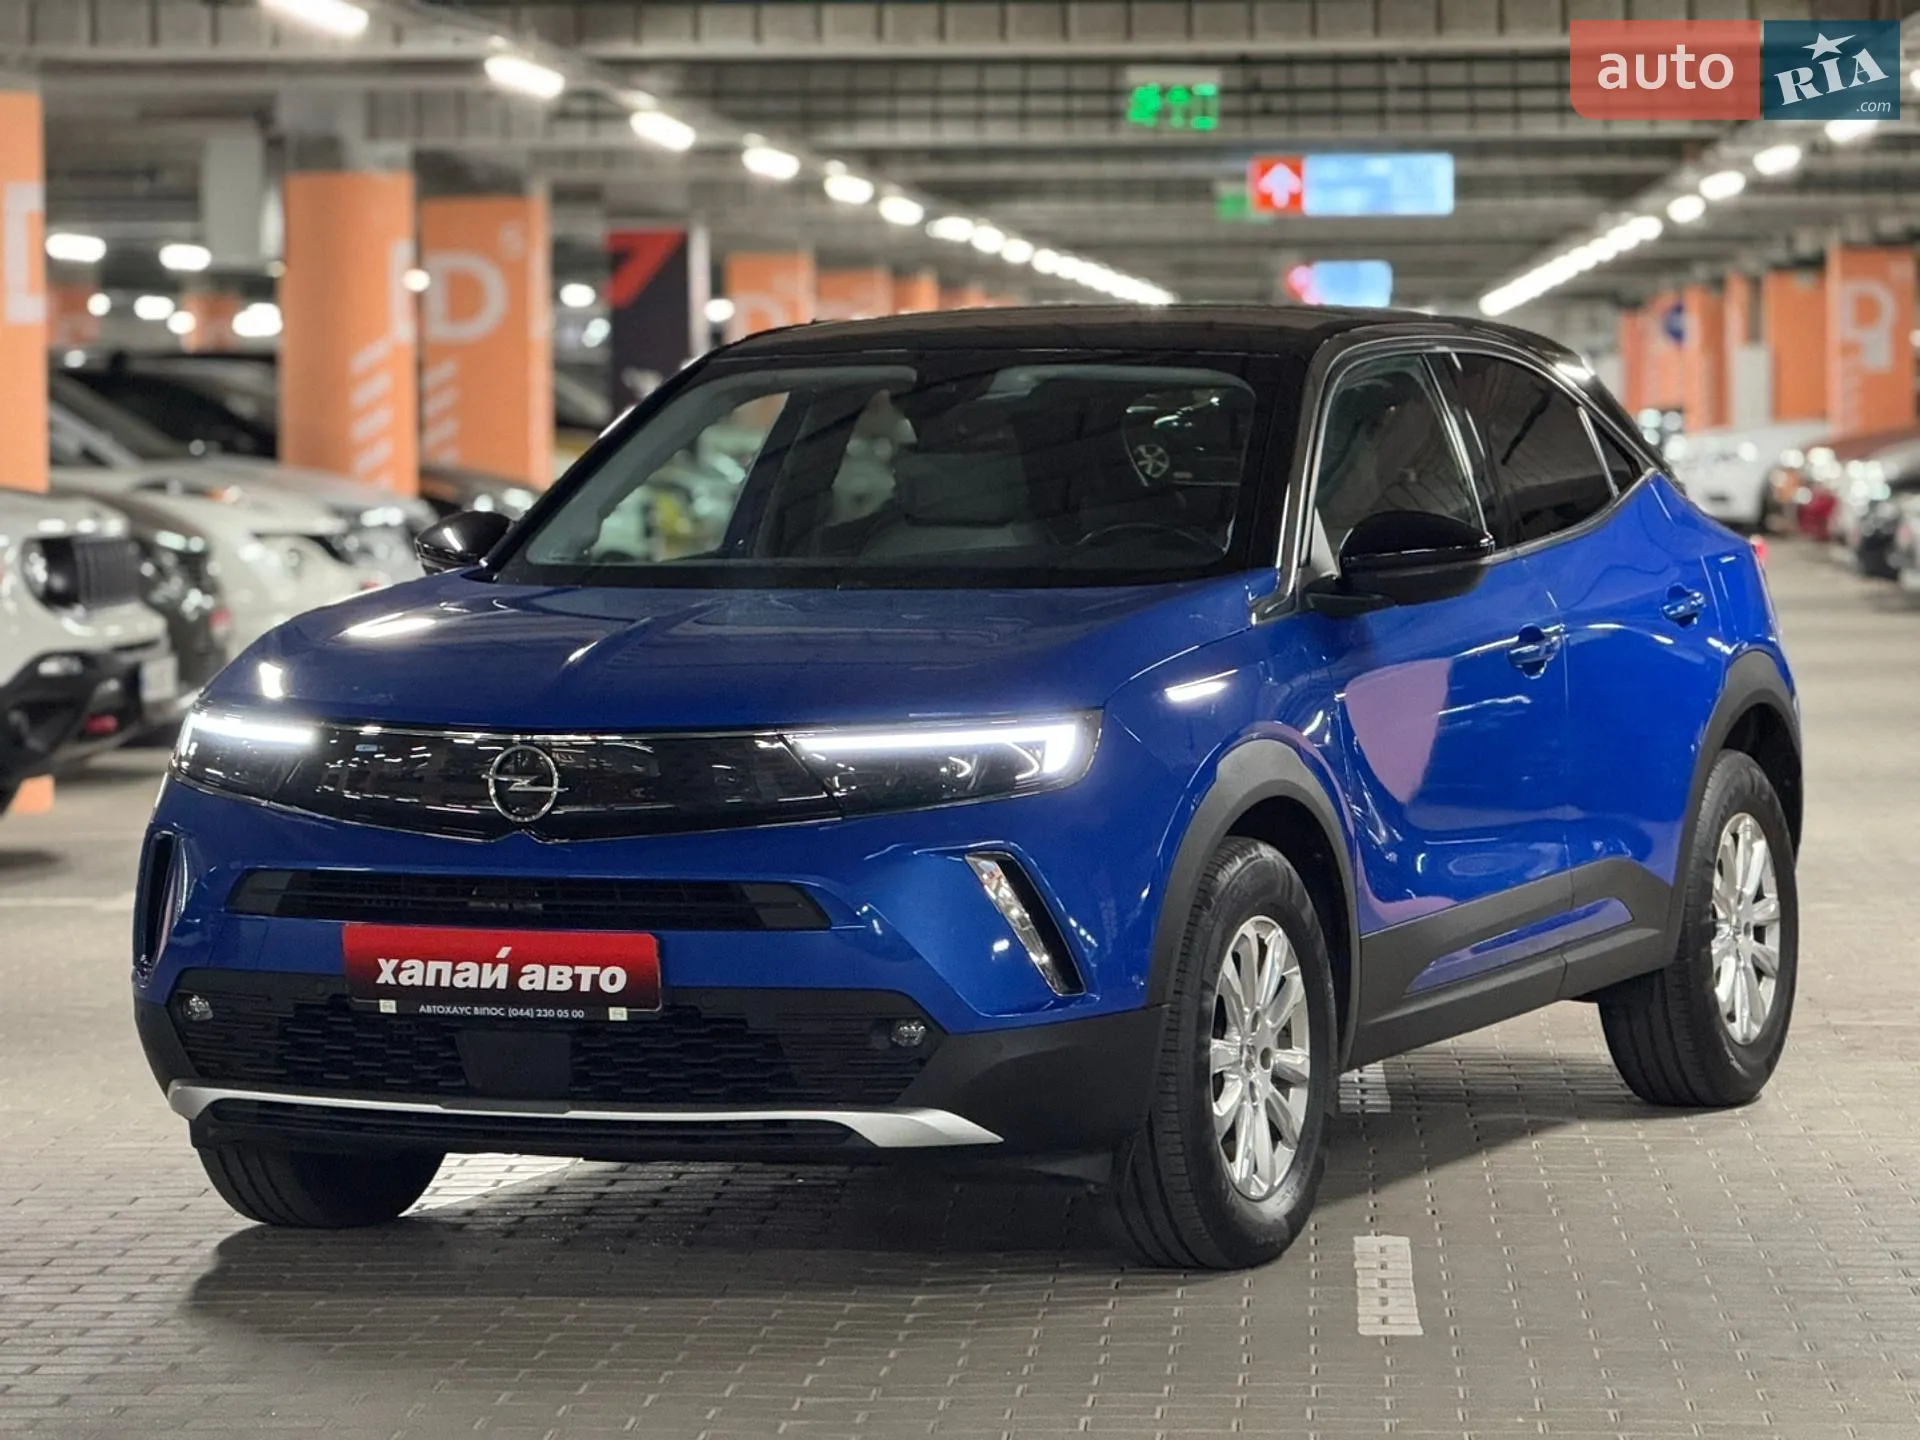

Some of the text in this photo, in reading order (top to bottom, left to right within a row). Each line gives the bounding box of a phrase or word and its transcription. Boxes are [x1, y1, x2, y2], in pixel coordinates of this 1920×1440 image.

[376, 946, 627, 993] хапай авто
[419, 1004, 471, 1015] АВТОХАУС
[508, 1006, 534, 1018] (044)
[535, 1008, 555, 1018] 230
[556, 1008, 569, 1018] 05
[571, 1008, 585, 1019] 00
